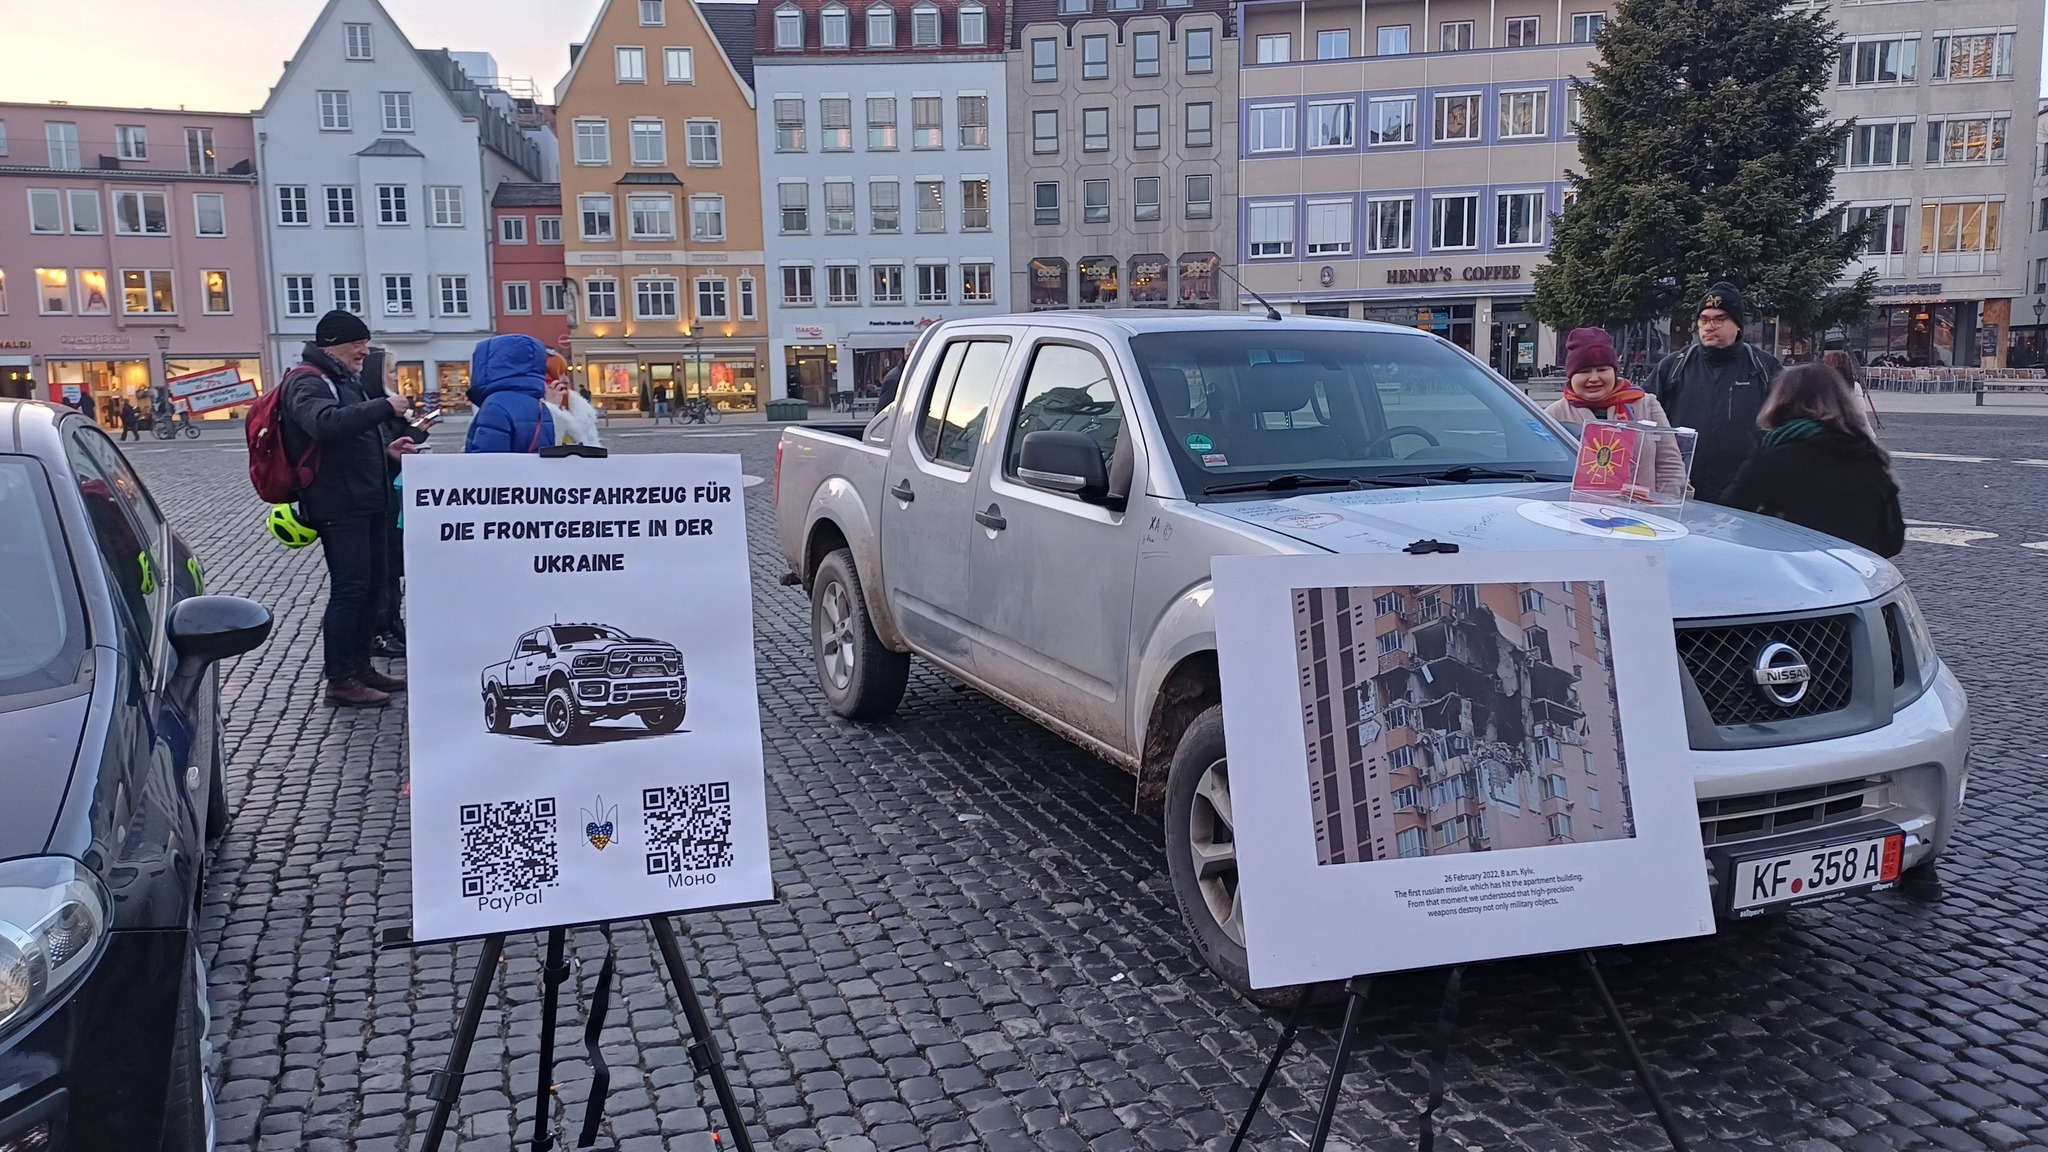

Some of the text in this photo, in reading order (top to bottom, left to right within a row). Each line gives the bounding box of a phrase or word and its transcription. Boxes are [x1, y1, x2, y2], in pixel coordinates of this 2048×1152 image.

[1386, 265, 1521, 284] HENRY'S COFFEE
[416, 481, 731, 506] EVAKUIERUNGSFAHRZEUG FÜR
[440, 519, 713, 541] DIE FRONTGEBIETE IN DER
[534, 553, 625, 573] UKRAINE
[637, 655, 657, 663] RAM
[1766, 668, 1810, 682] NISSAN
[1454, 873, 1481, 882] February
[1483, 871, 1500, 879] 2022,
[1520, 868, 1535, 876] Kyiv.
[1752, 843, 1879, 901] KF 358 A
[1395, 874, 1583, 898] The first russian missile, which has hit the apartment building.
[1408, 899, 1425, 908] From
[1426, 898, 1440, 906] that
[1441, 895, 1468, 905] moment
[1480, 891, 1515, 901] understood
[1517, 889, 1530, 898] that
[1531, 885, 1574, 896] high-precision
[478, 889, 542, 913] PayPal
[1428, 897, 1559, 918] weapons destroy not only military objects.
